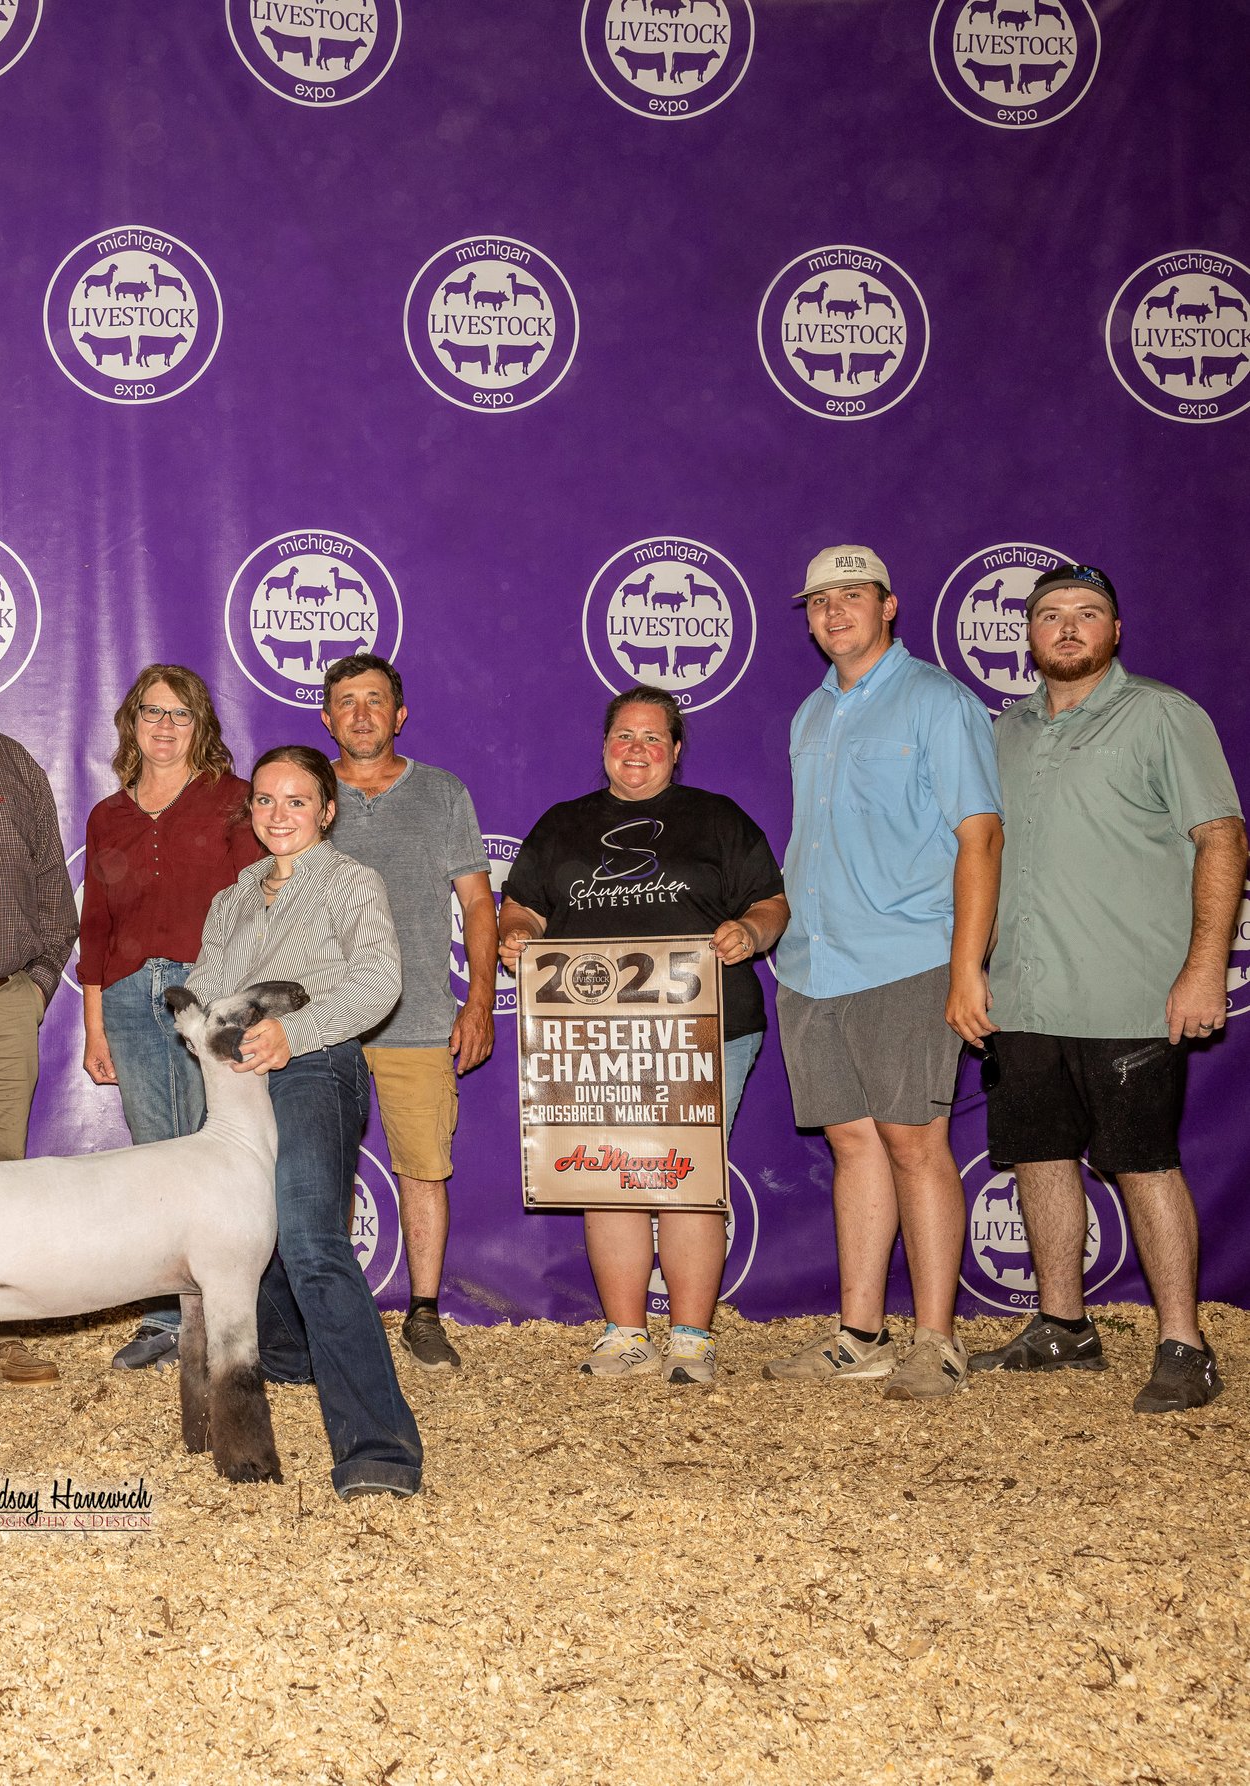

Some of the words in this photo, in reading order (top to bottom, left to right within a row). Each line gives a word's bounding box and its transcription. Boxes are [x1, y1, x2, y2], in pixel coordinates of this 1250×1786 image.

[252, 0, 375, 33] LIVESTOCK
[607, 21, 728, 45] LIVESTOCK
[955, 33, 1074, 56] LIVESTOCK
[294, 83, 335, 101] expo
[648, 97, 689, 115] expo
[997, 107, 1038, 125] expo
[97, 231, 173, 256] michigan
[455, 240, 531, 265] michigan
[808, 249, 883, 274] michigan
[1157, 254, 1233, 278] michigan
[70, 306, 195, 329] LIVESTOCK
[430, 314, 553, 337] LIVESTOCK
[784, 322, 904, 345] LIVESTOCK
[114, 381, 156, 400] expo
[472, 390, 514, 407] expo
[825, 399, 866, 415] expo
[1178, 401, 1219, 419] expo
[277, 535, 353, 558] michigan
[633, 543, 709, 564] michigan
[983, 549, 1058, 570] michigan
[252, 609, 375, 632] LIVESTOCK
[609, 615, 730, 638] LIVESTOCK
[959, 621, 1030, 641] LIVEST
[295, 687, 325, 704] exp
[577, 892, 679, 911] LIVESTOCK
[543, 1019, 698, 1050] RESERVE
[530, 1052, 714, 1082] CHAMPION
[575, 1086, 641, 1103] DIVISION
[655, 1086, 669, 1102] 2
[530, 1105, 604, 1123] CROSSBRED
[616, 1105, 668, 1122] MARKET
[679, 1105, 715, 1122] LAMB
[620, 1172, 678, 1189] FARMS
[1009, 1293, 1039, 1307] exp
